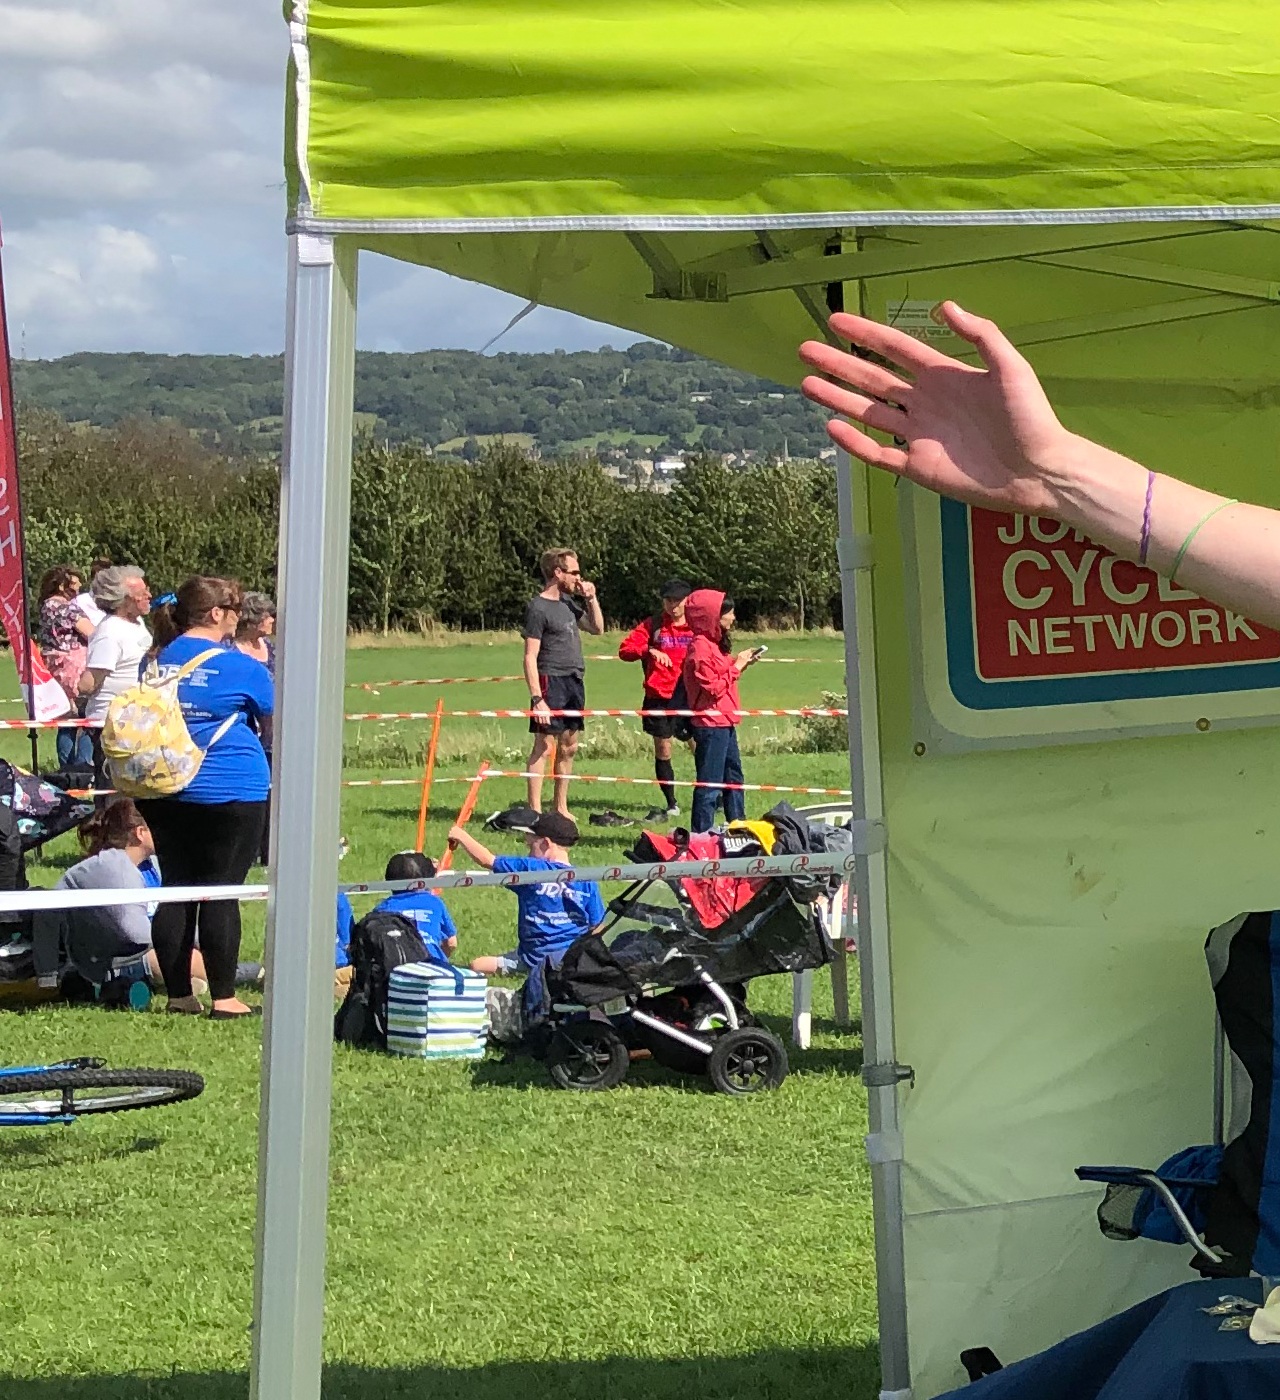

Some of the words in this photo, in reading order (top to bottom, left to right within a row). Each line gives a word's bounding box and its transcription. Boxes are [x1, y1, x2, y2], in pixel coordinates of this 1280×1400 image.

[997, 512, 1098, 544] JO
[1002, 549, 1200, 610] CYCL
[1007, 607, 1260, 657] NETWORK
